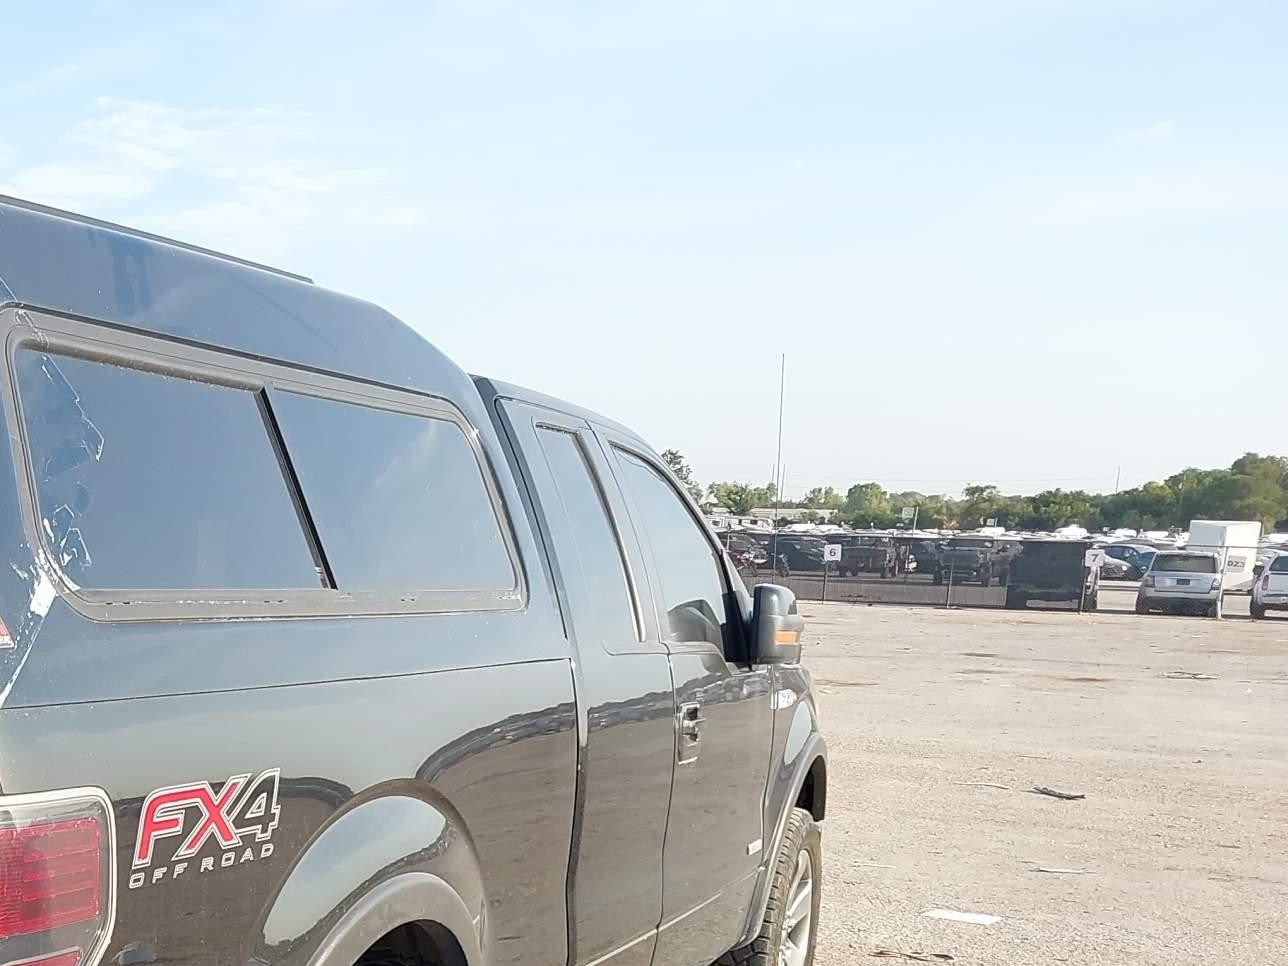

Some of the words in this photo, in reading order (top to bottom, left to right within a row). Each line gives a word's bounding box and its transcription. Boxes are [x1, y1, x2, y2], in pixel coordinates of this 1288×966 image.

[132, 768, 282, 870] FX4
[128, 862, 188, 889] OFF
[200, 843, 274, 873] ROAD
